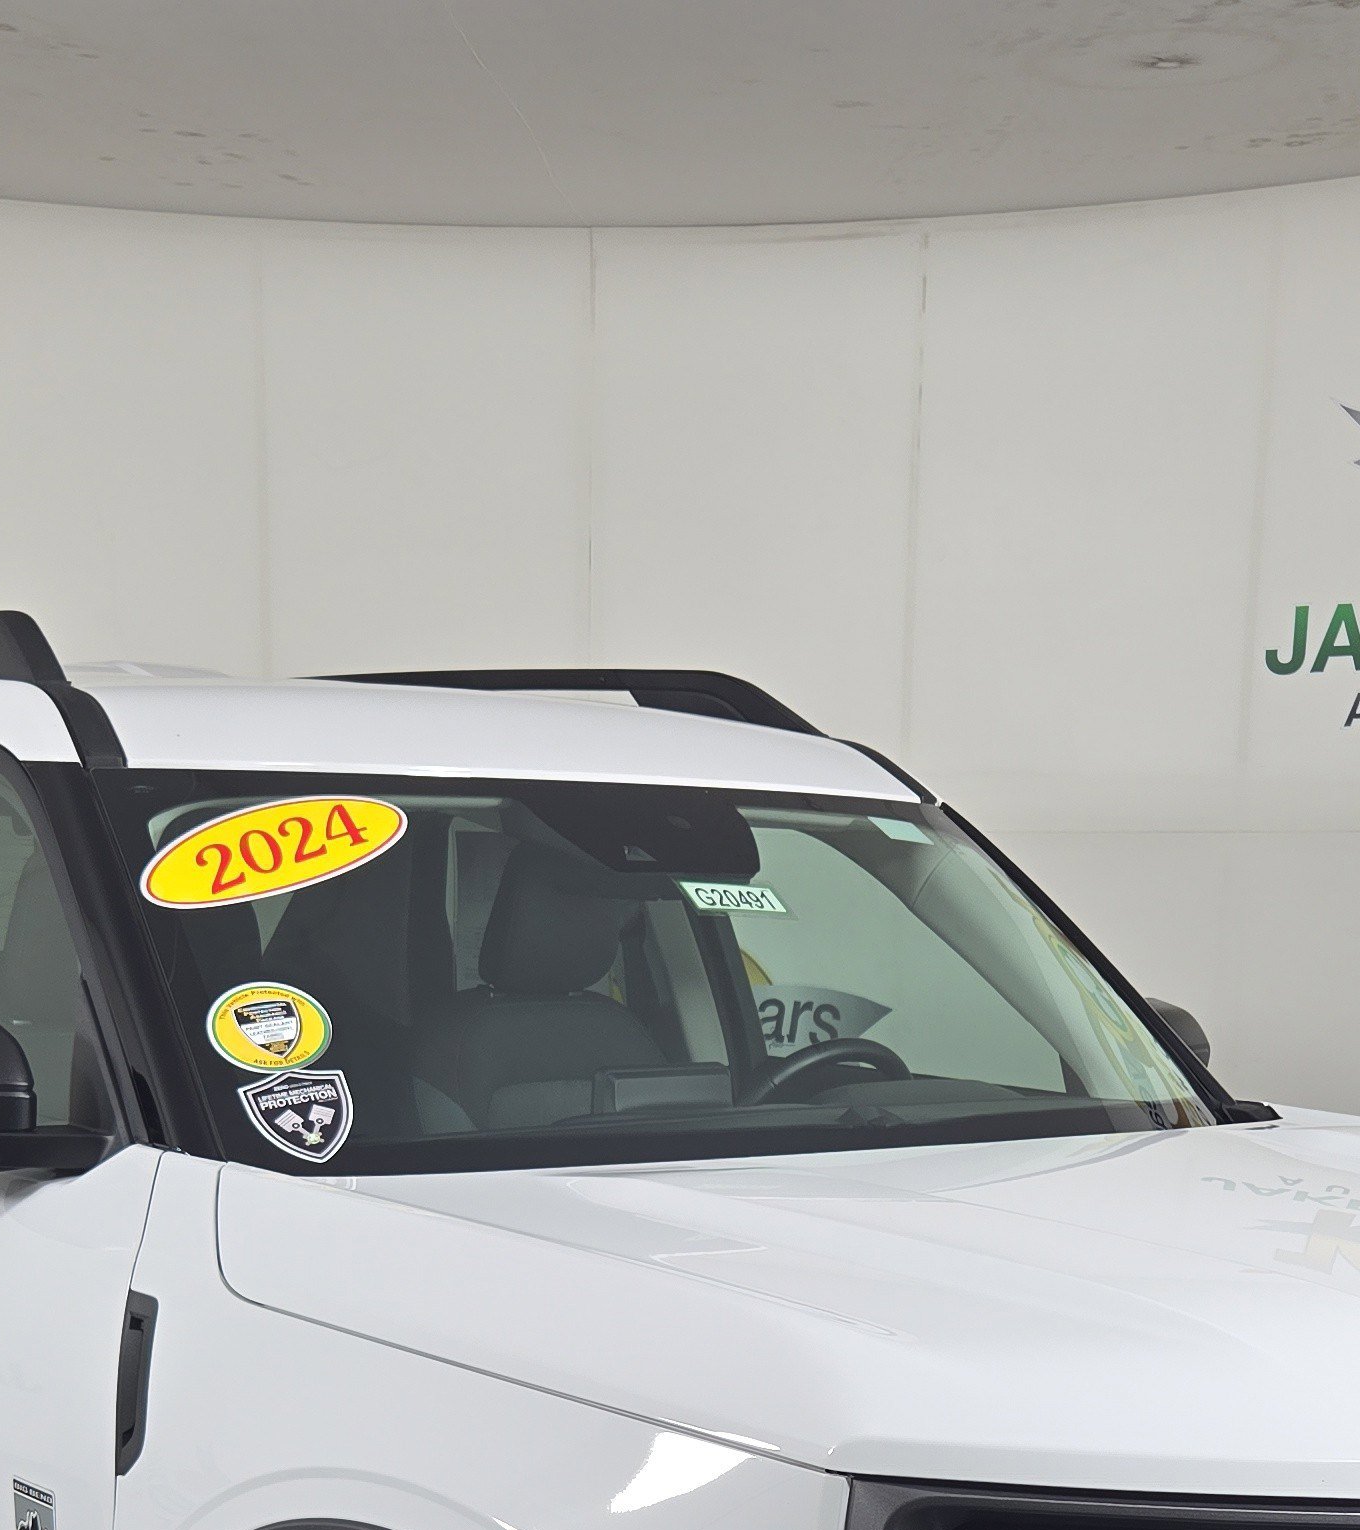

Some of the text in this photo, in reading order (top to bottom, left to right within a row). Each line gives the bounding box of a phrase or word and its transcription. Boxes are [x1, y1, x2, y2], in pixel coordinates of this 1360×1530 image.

[195, 803, 368, 895] 2024
[694, 887, 777, 910] G20491
[260, 1088, 338, 1111] PROTECTION
